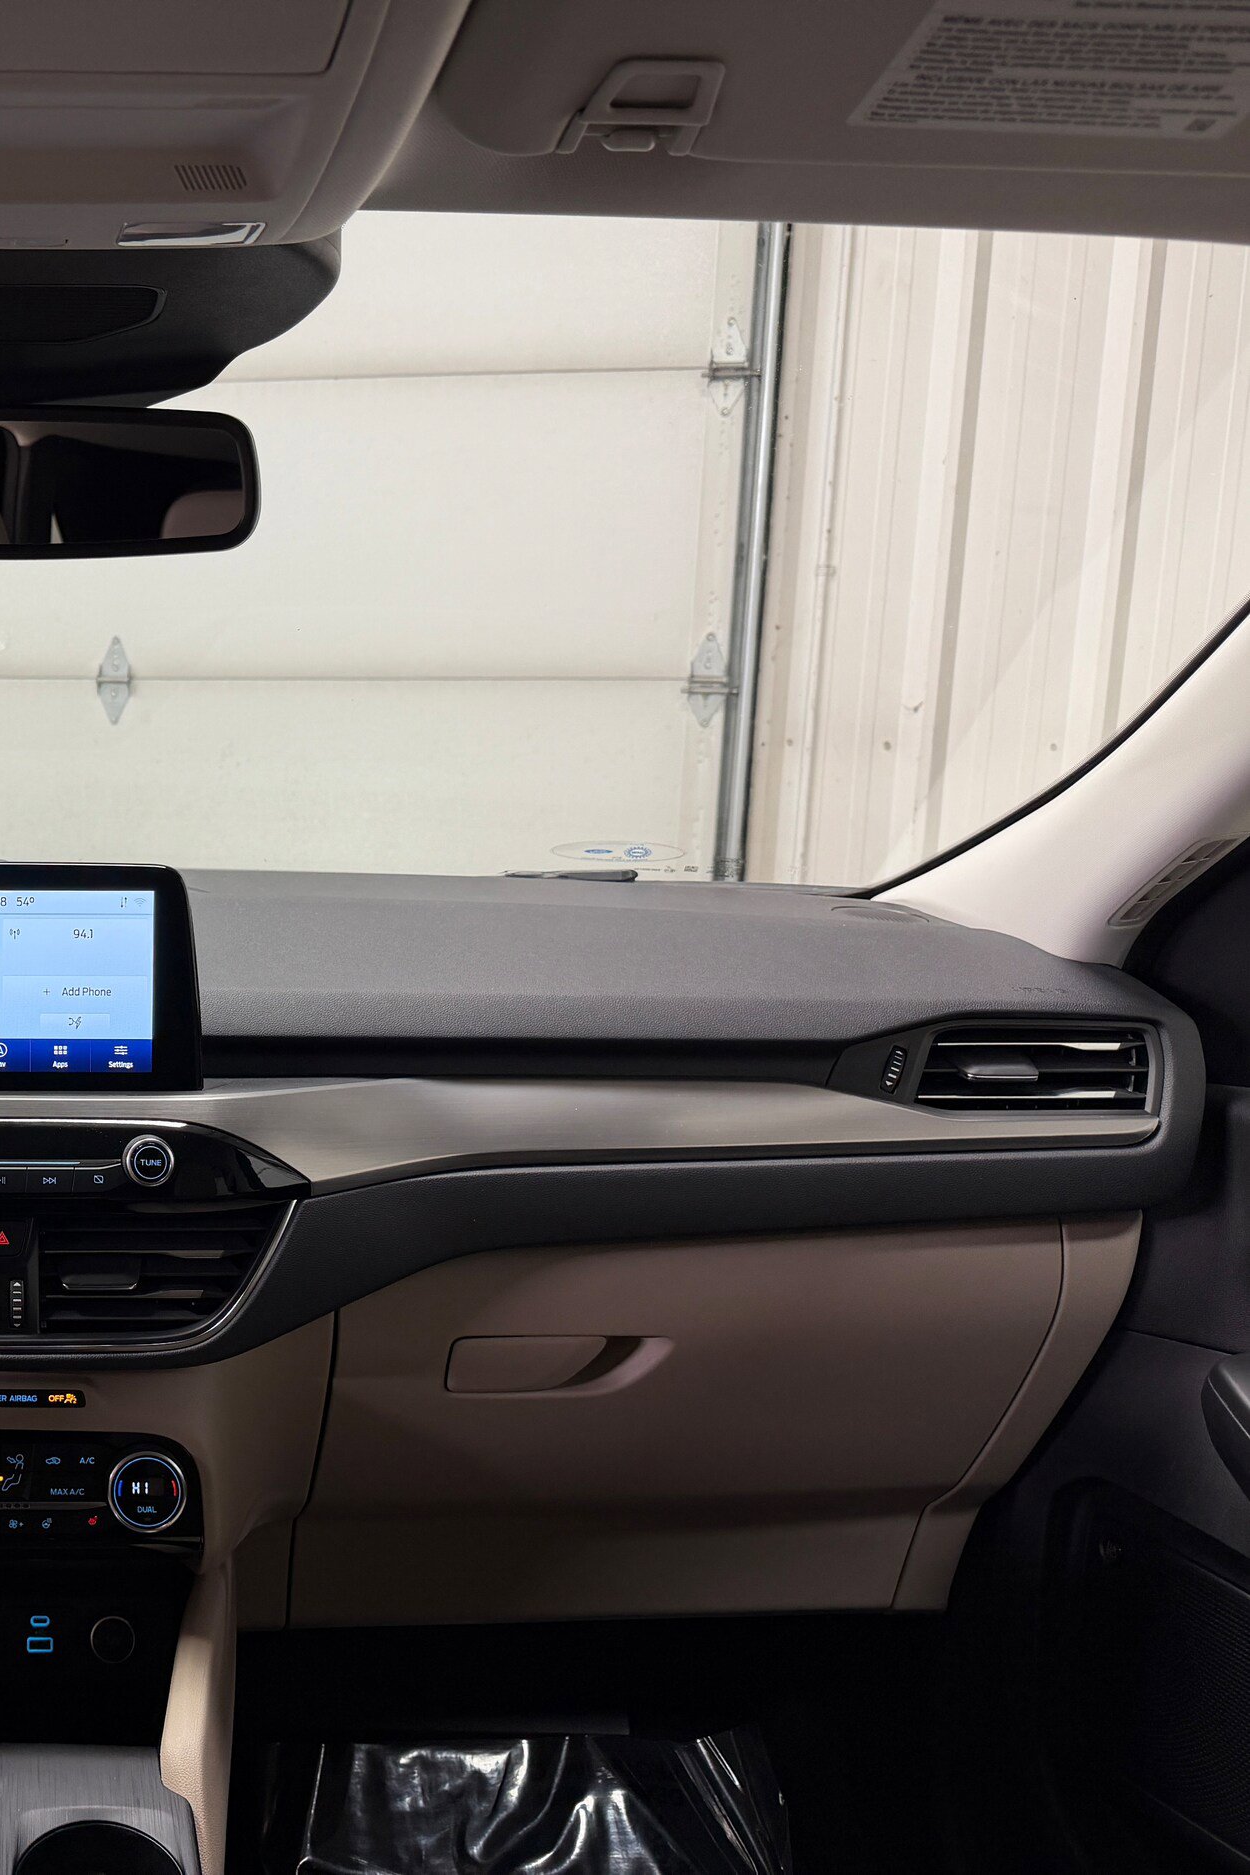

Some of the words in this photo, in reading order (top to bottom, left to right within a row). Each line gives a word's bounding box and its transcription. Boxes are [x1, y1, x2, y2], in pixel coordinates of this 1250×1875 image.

[74, 928, 93, 939] 94.1
[61, 986, 81, 997] Add
[83, 986, 112, 997] Phone
[52, 1060, 68, 1069] Apps
[108, 1060, 134, 1070] Settings
[140, 1158, 162, 1167] TUNE
[9, 1394, 38, 1402] AIRBAG
[48, 1394, 65, 1403] OFF
[79, 1456, 95, 1465] A/C
[49, 1487, 68, 1496] MAX
[69, 1487, 85, 1496] A/C
[136, 1505, 158, 1514] DUAL
